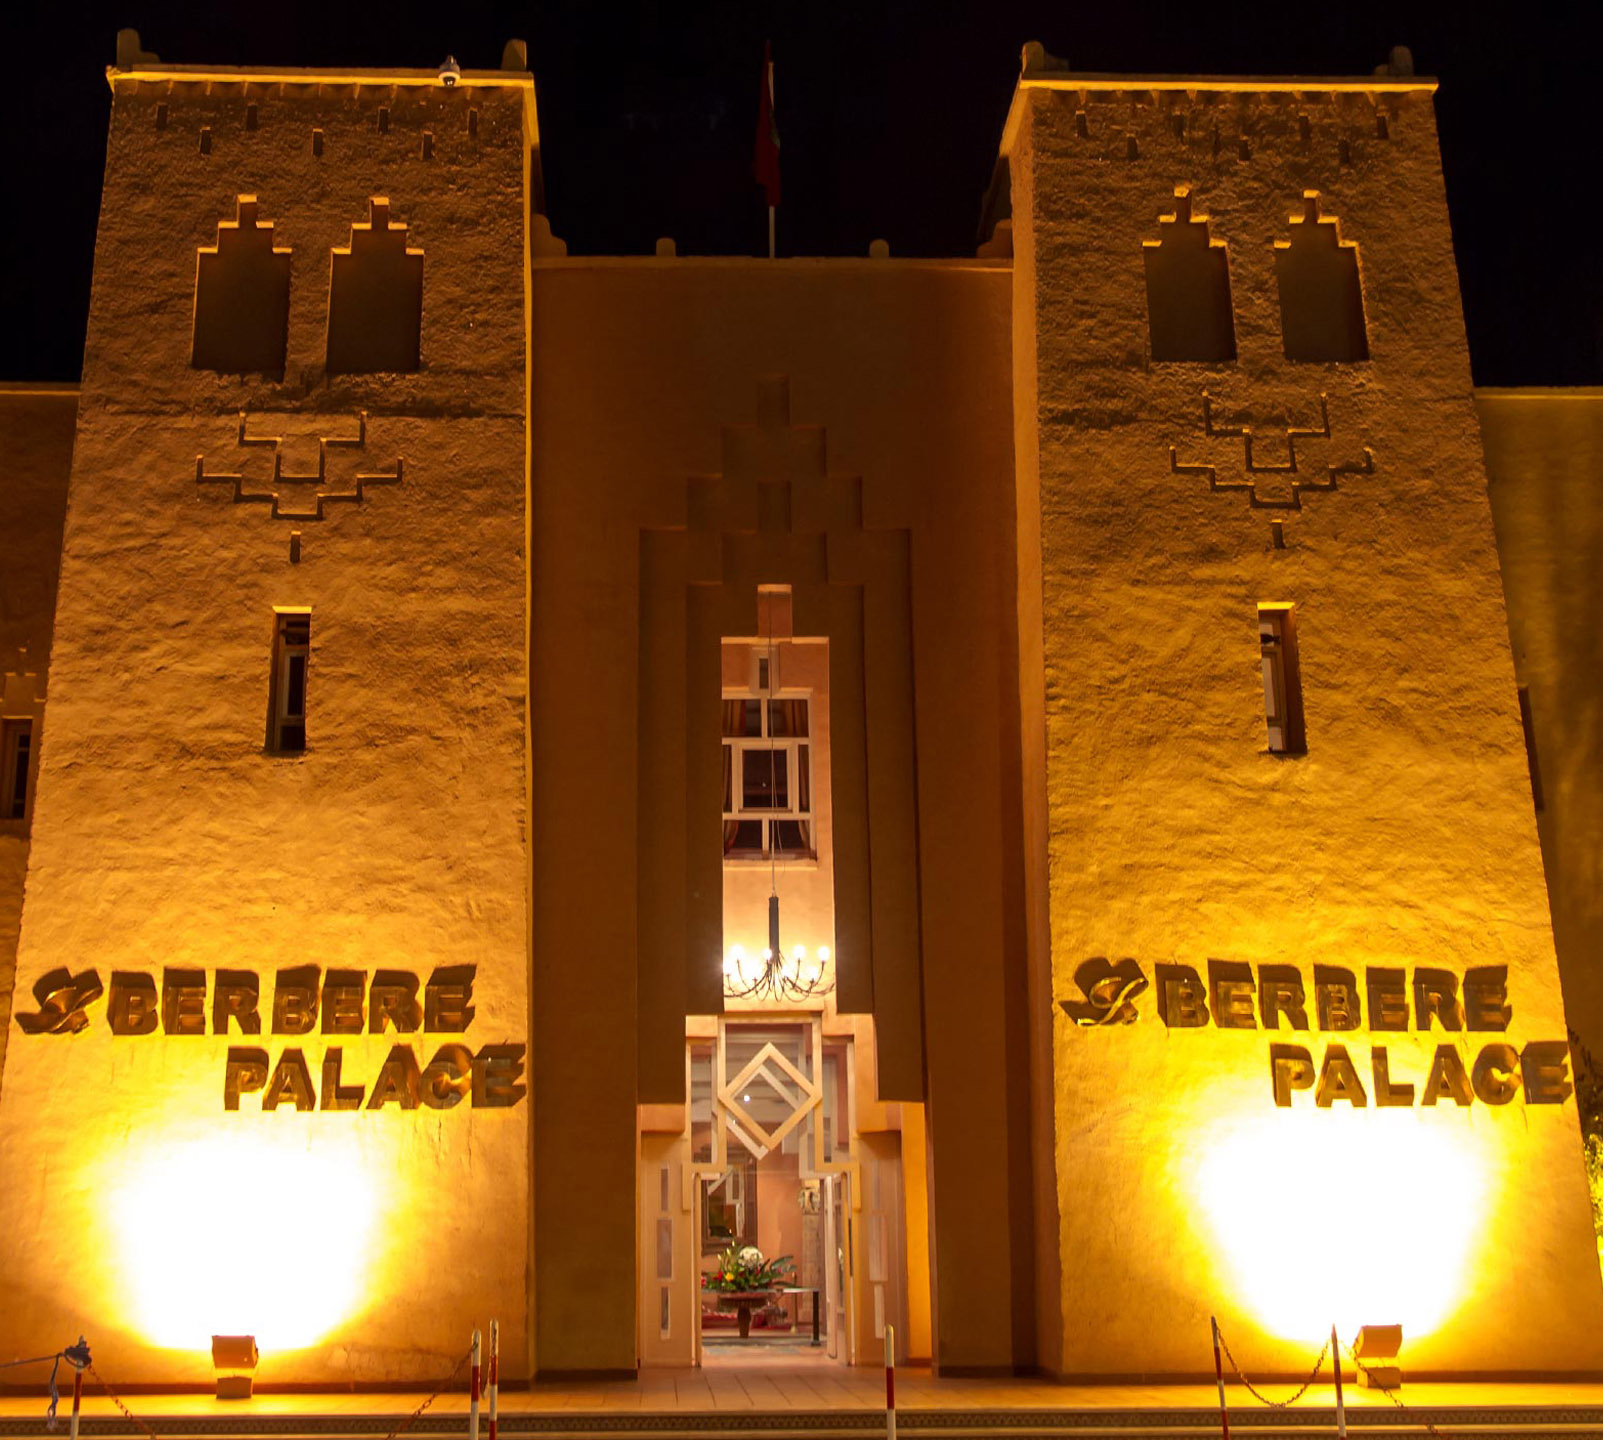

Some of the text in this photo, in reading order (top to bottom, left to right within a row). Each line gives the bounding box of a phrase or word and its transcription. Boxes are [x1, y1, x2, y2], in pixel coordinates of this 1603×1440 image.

[108, 966, 476, 1035] BERBERE
[1155, 961, 1512, 1032] BERBERE
[224, 1044, 526, 1110] PALACE
[1270, 1042, 1573, 1107] PALACE
